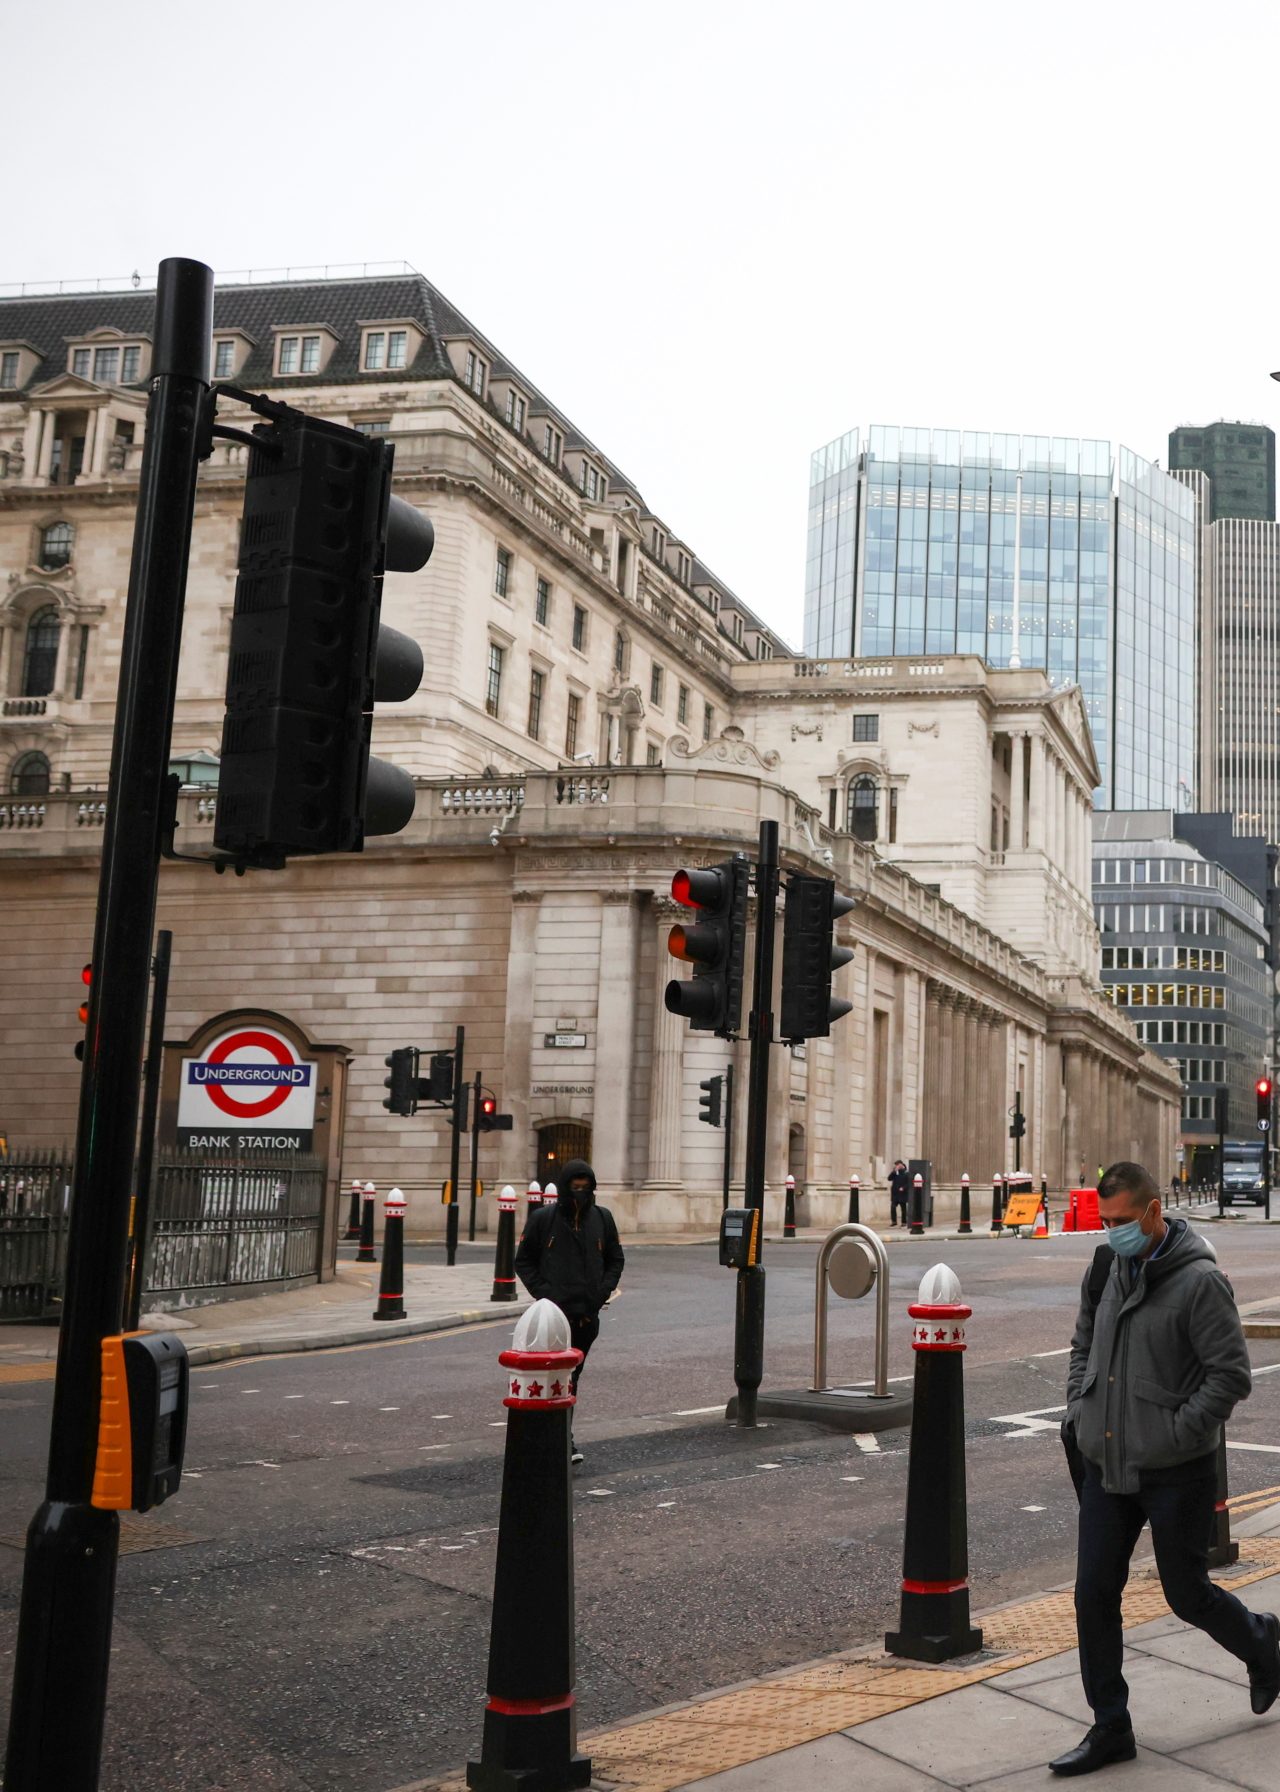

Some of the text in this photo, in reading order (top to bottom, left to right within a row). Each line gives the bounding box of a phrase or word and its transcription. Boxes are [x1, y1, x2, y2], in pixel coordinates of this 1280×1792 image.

[194, 1066, 304, 1083] UNDERGROUND
[533, 1086, 594, 1094] UNDERGROUND
[189, 1135, 300, 1149] BANK STATION
